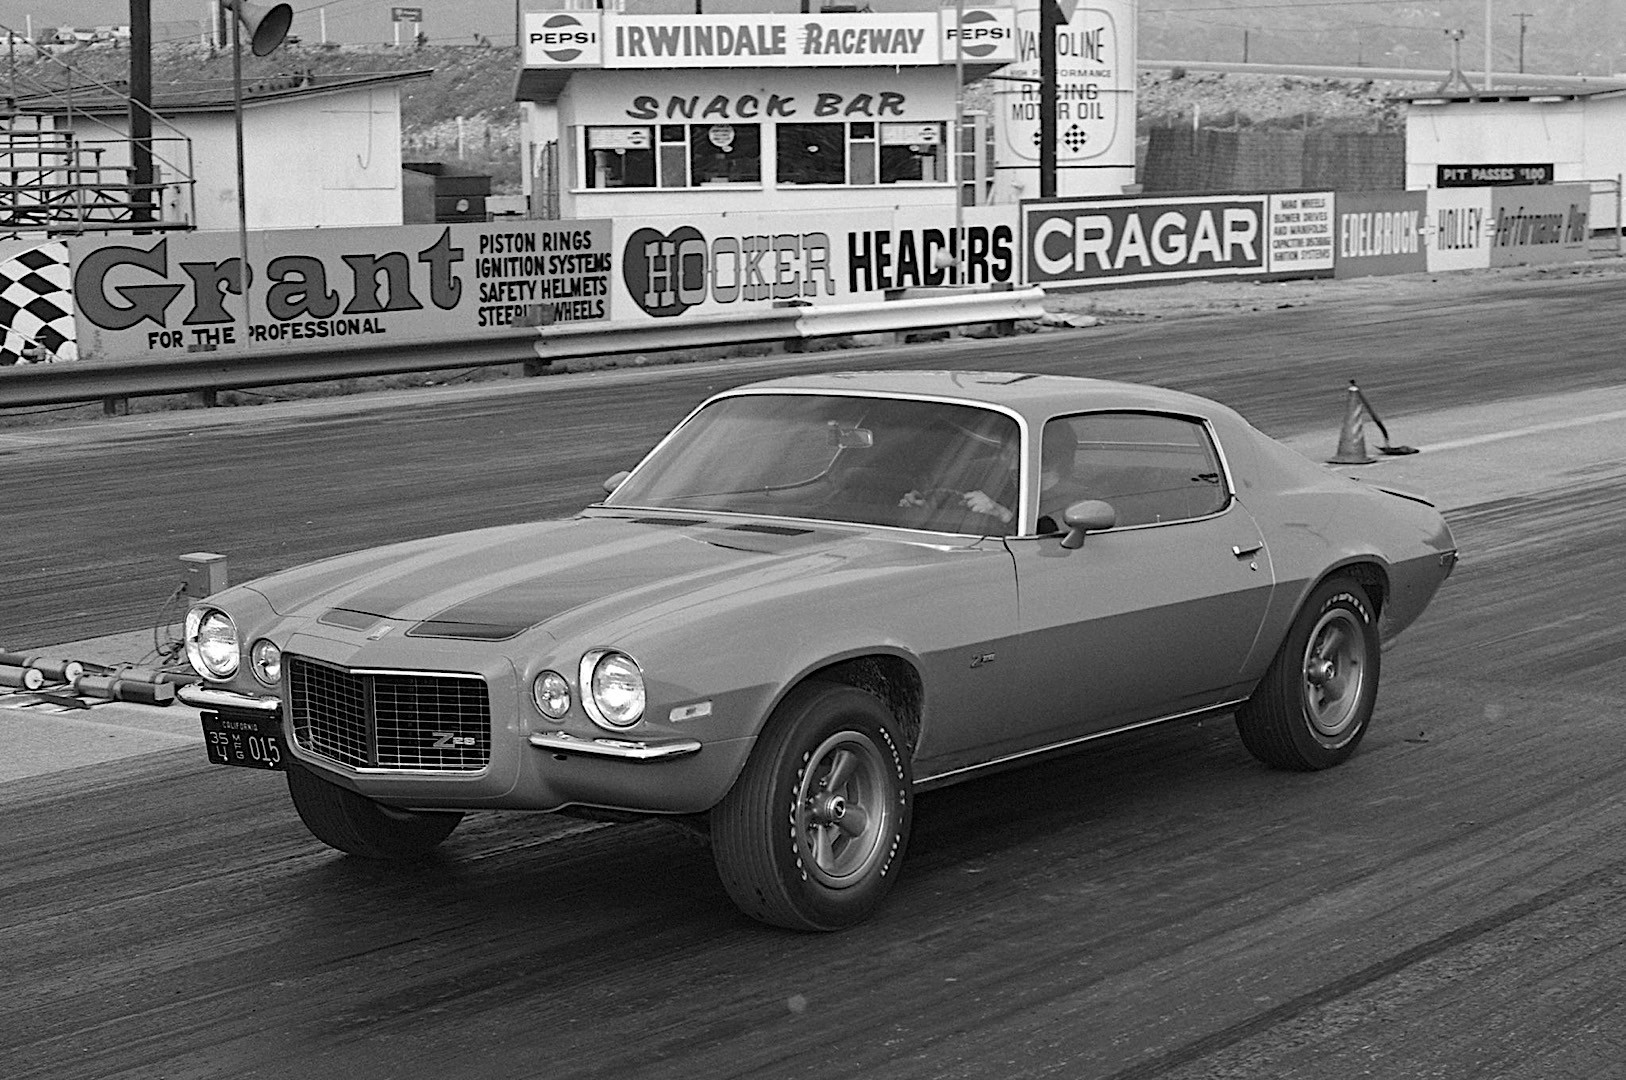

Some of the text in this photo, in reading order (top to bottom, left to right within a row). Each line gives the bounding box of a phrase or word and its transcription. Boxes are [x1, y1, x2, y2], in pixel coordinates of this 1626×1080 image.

[530, 32, 596, 44] PEPSI
[615, 22, 924, 57] IRWINDALE RACEWAY
[946, 27, 1011, 40] PEPSI
[1017, 26, 1105, 63] VAOLINE
[626, 91, 906, 120] SNACK BAR
[1077, 102, 1104, 120] OIL
[1443, 168, 1468, 181] PIT
[1471, 168, 1515, 180] PASSES
[479, 230, 592, 254] PISTON RINGS
[1033, 208, 1258, 275] CRAGAR
[1341, 210, 1419, 258] EDELBROCK
[1438, 207, 1483, 250] HOLLEY
[475, 252, 612, 279] IGNITION SYSTEMS
[643, 224, 1013, 309] HOOKER HEADERS
[74, 236, 464, 332] Grant
[479, 275, 608, 303] SAFETY HELMETS
[149, 331, 183, 350] FOR
[191, 327, 236, 346] THE
[209, 731, 229, 745] 35
[248, 736, 280, 763] 015
